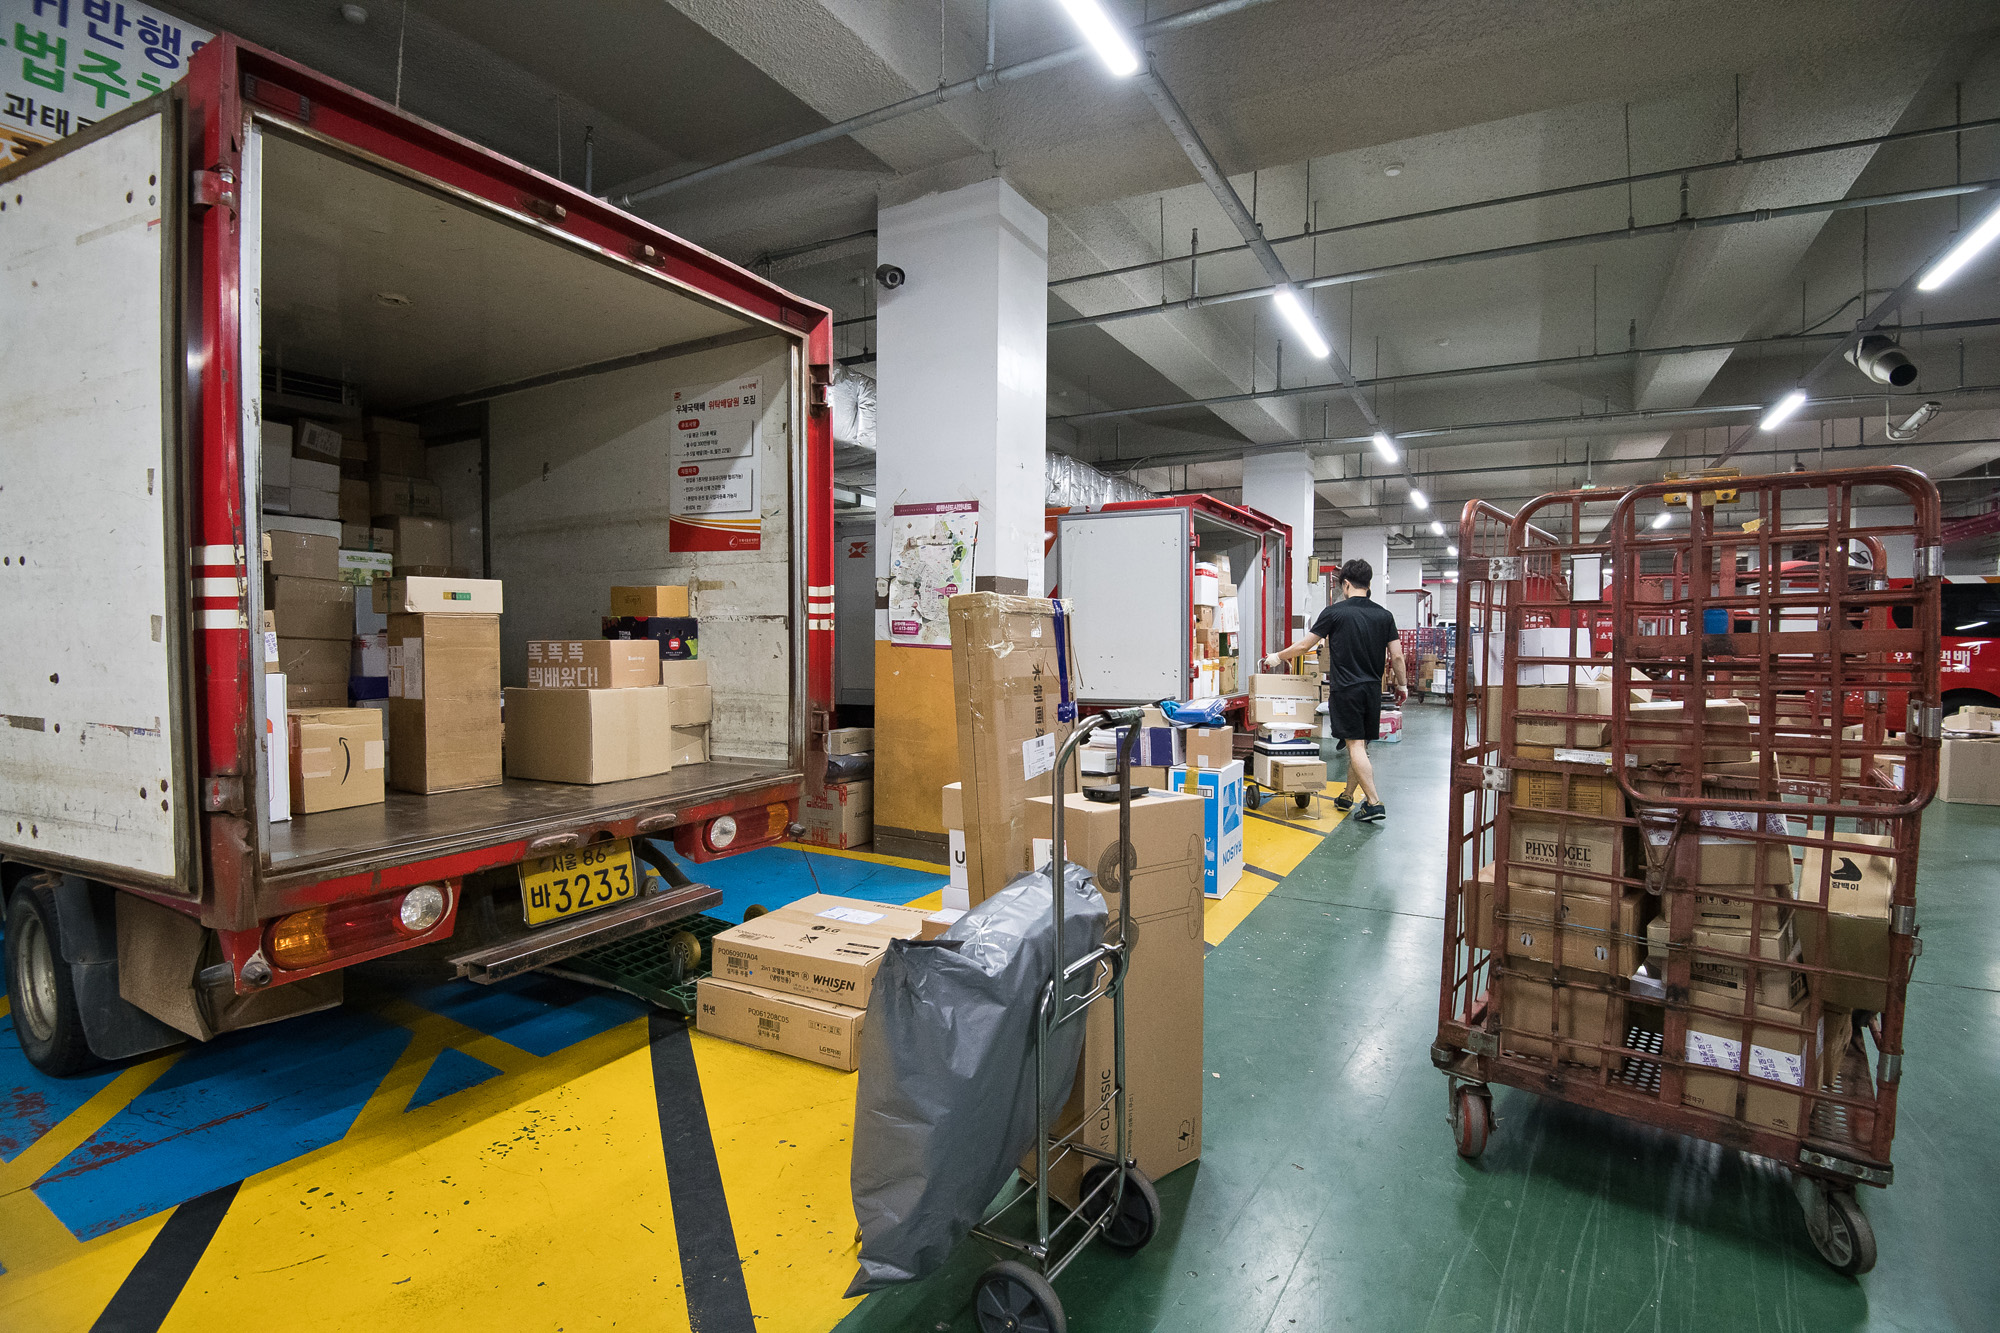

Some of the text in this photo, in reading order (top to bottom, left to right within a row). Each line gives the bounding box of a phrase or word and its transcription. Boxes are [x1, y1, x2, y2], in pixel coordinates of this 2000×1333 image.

[676, 395, 756, 414] 우체국택배 위탁배달원 모집
[528, 666, 599, 688] 택배왔다!
[551, 849, 606, 872] 서울 86
[813, 974, 855, 992] WHISEN
[702, 1003, 716, 1016] 휘센
[1100, 1068, 1111, 1131] CLASSIC
